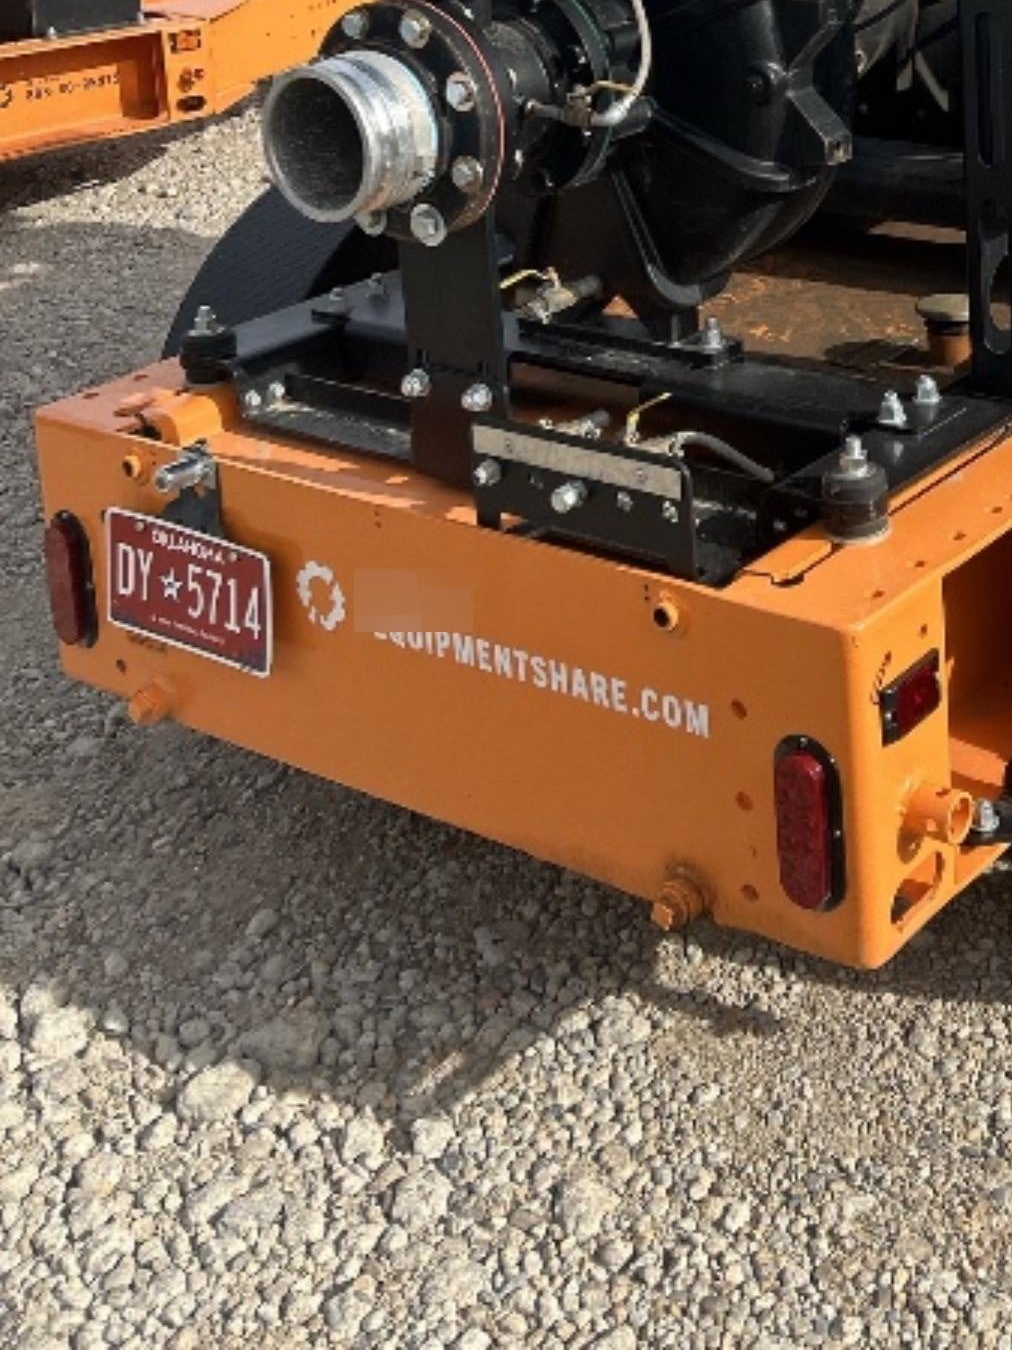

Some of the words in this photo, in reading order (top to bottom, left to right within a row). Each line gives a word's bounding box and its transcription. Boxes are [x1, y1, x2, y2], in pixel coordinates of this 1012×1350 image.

[118, 542, 153, 601] DY
[187, 563, 262, 640] 5714
[152, 529, 225, 564] OKLAHOMA
[373, 631, 710, 738] QUIPMENTSHARE.COM
